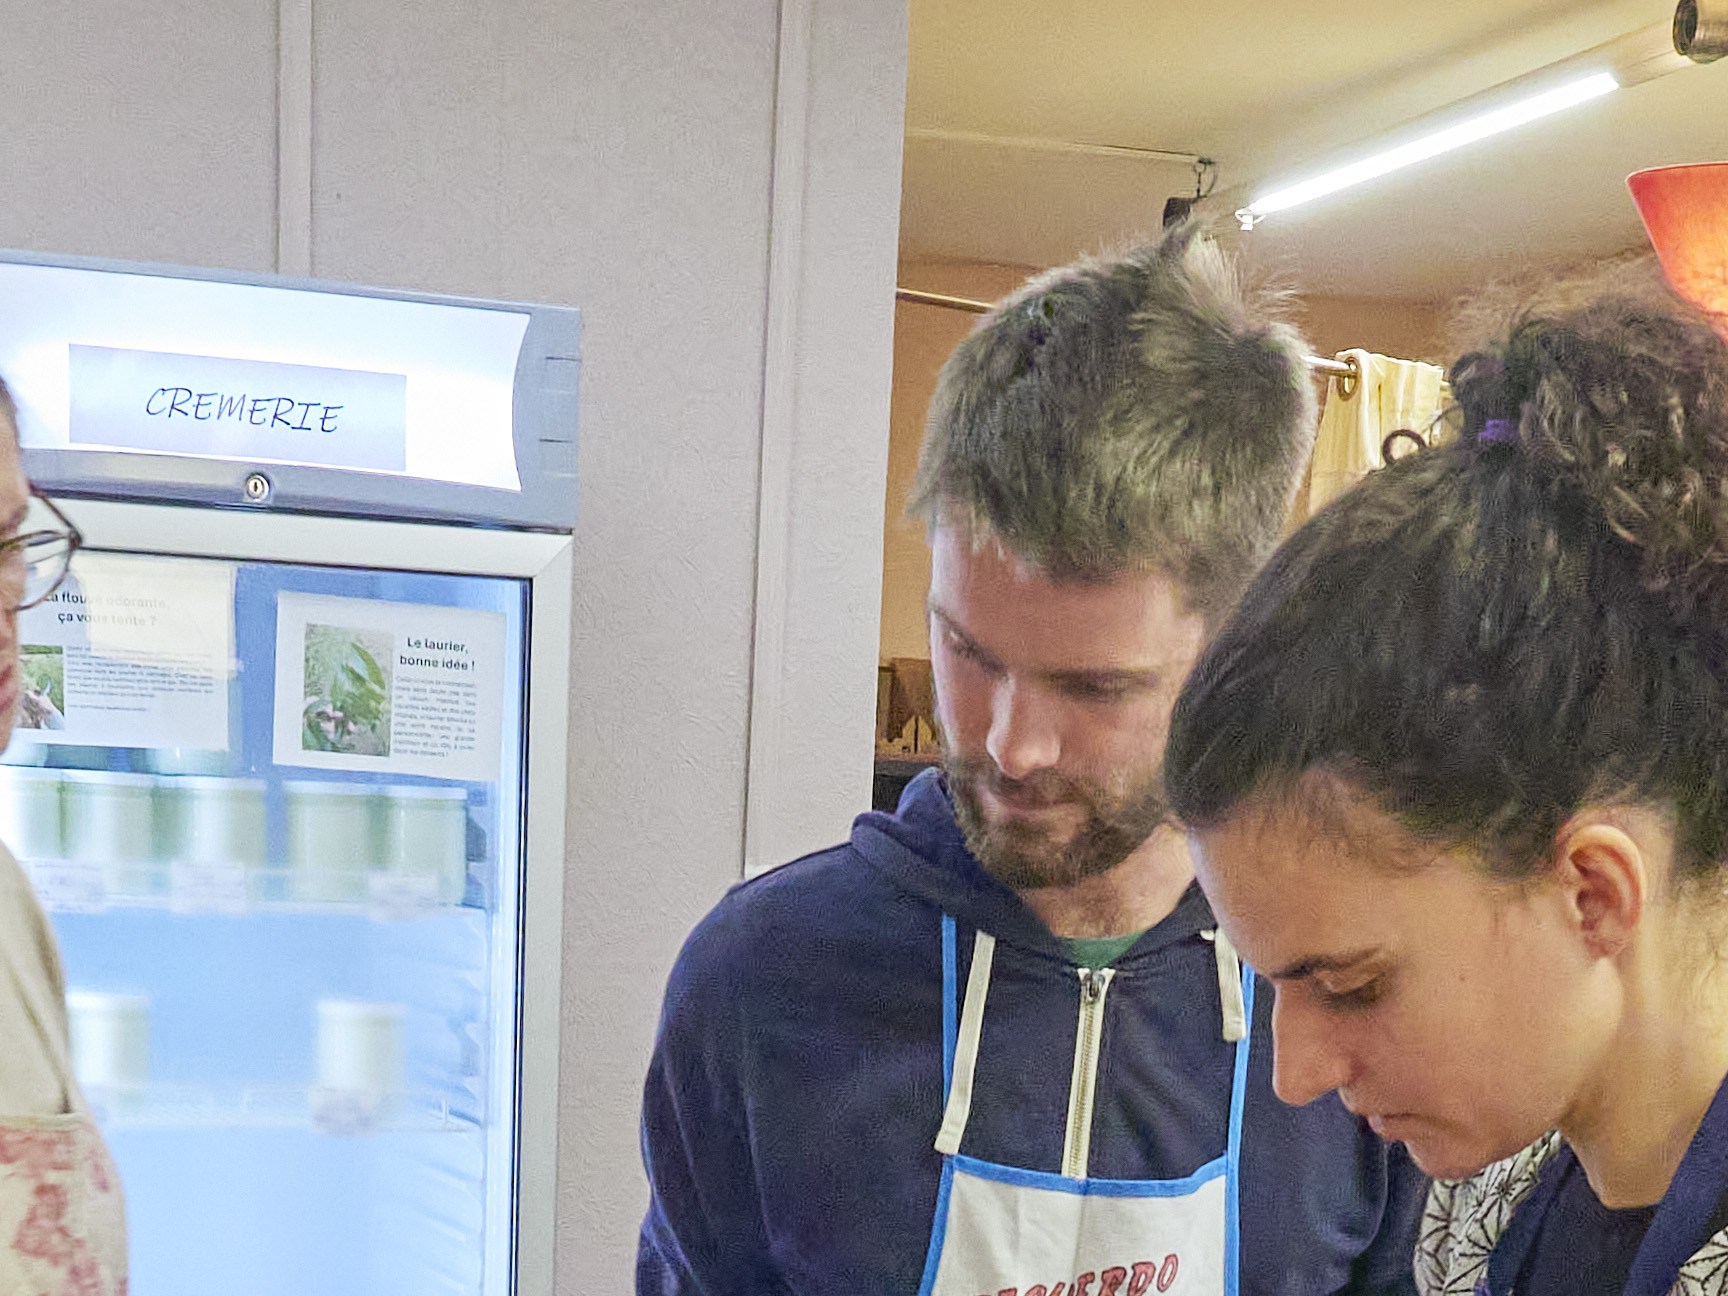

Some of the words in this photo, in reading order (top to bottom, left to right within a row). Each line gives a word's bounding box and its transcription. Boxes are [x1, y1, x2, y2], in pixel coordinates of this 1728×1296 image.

[145, 387, 345, 433] CREMERIE
[407, 636, 422, 649] Le
[424, 638, 469, 655] laurier,
[400, 655, 439, 669] bonne
